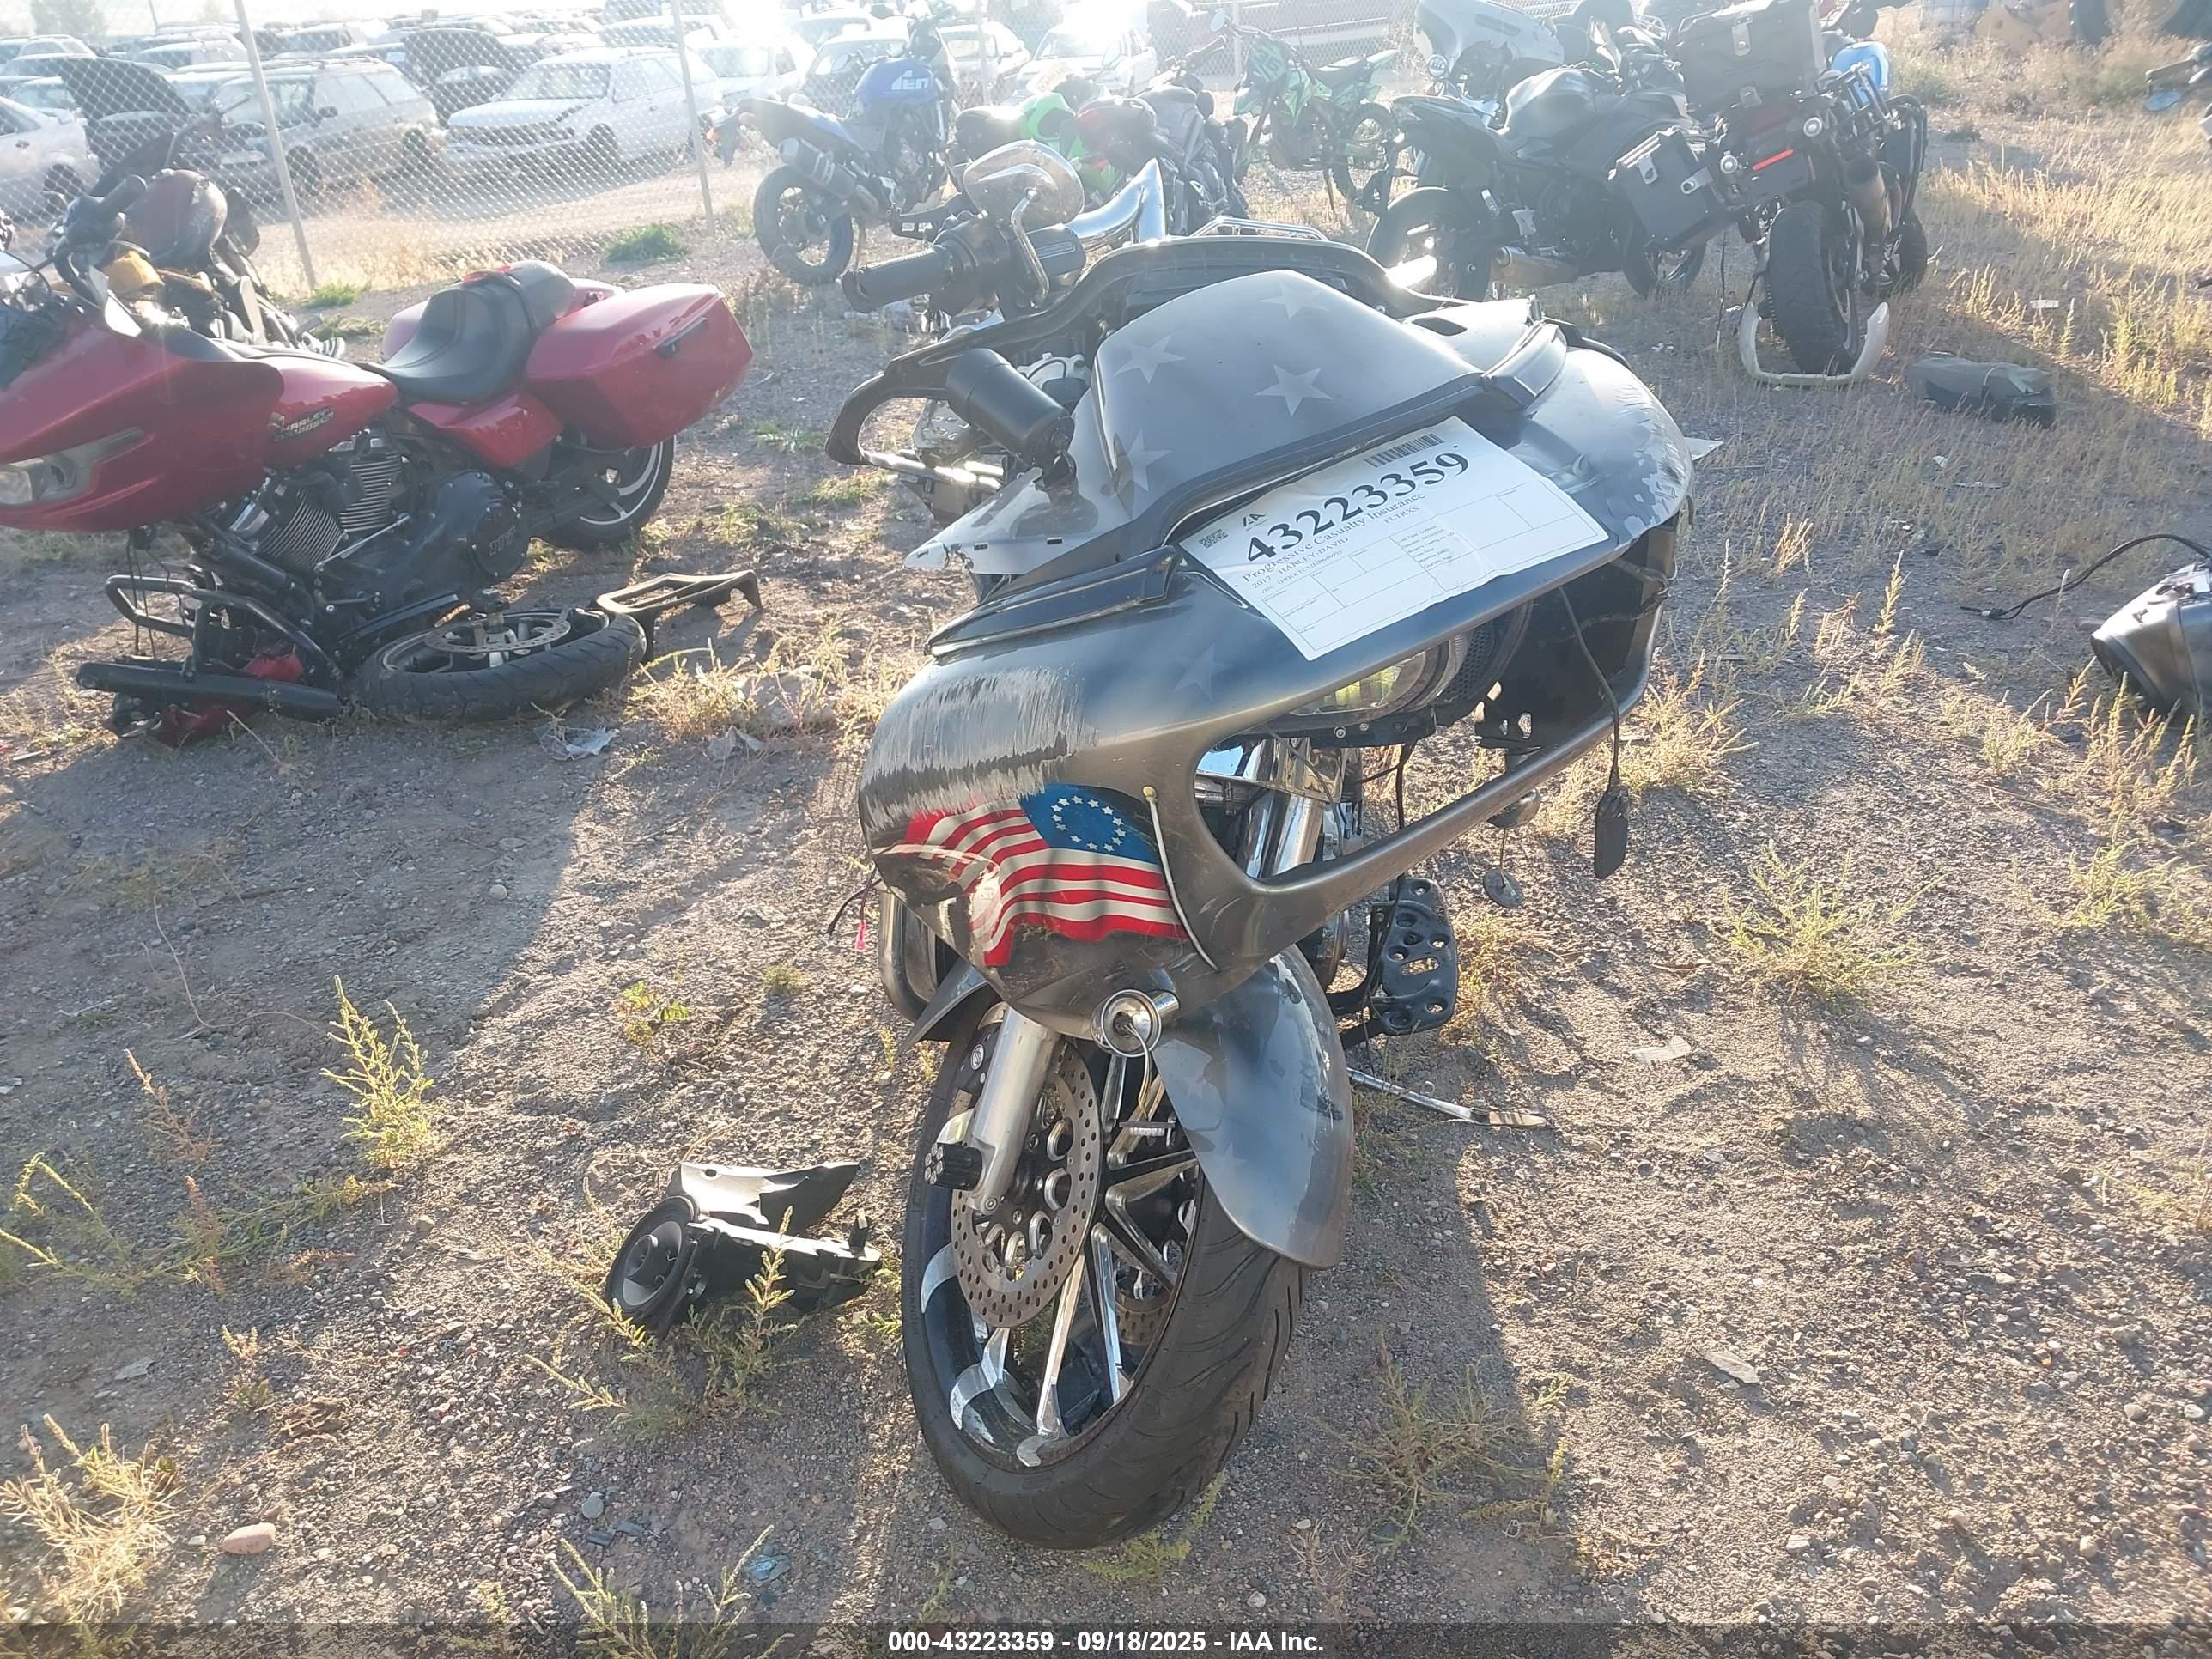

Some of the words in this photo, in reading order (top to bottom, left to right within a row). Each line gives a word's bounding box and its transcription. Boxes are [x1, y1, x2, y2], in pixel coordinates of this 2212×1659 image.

[1243, 543, 1313, 582] Progressive
[1314, 515, 1367, 544] Casualty
[1369, 492, 1425, 521] Insurance
[1248, 453, 1469, 562] 43223359
[1251, 574, 1272, 589] 2017
[1278, 536, 1349, 574] HARLEY-DAVID
